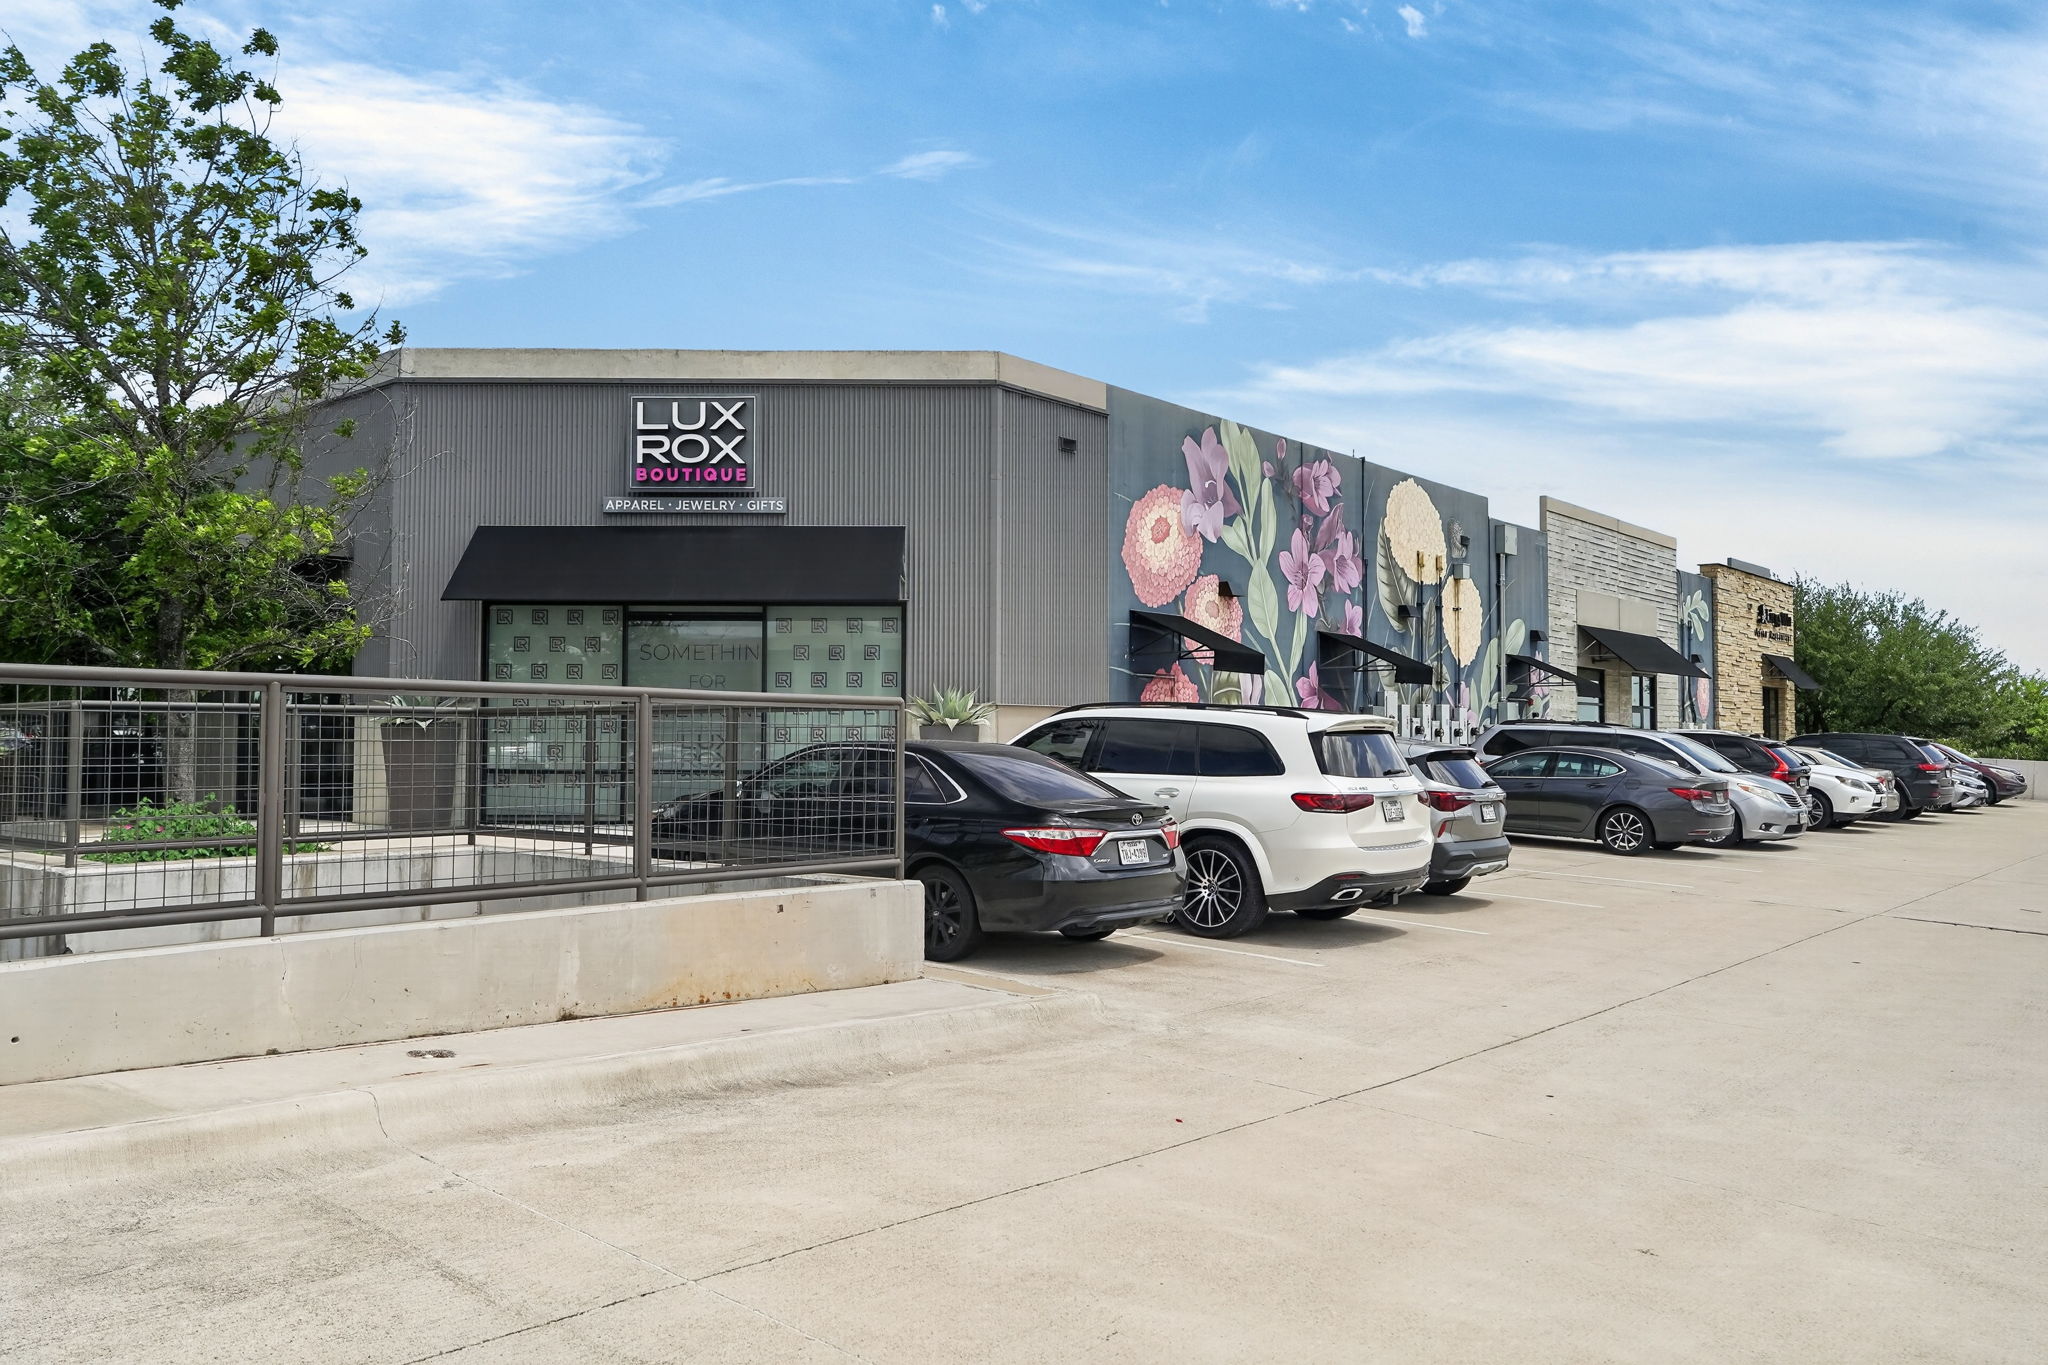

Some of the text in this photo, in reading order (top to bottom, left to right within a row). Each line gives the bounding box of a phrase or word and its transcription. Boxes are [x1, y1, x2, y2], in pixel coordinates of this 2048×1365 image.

[636, 401, 746, 430] LUX
[636, 433, 746, 464] ROX
[635, 467, 747, 482] BOUTIQUE
[605, 500, 784, 511] APPAREL JEWELRY GIFTS
[689, 674, 727, 689] FOR
